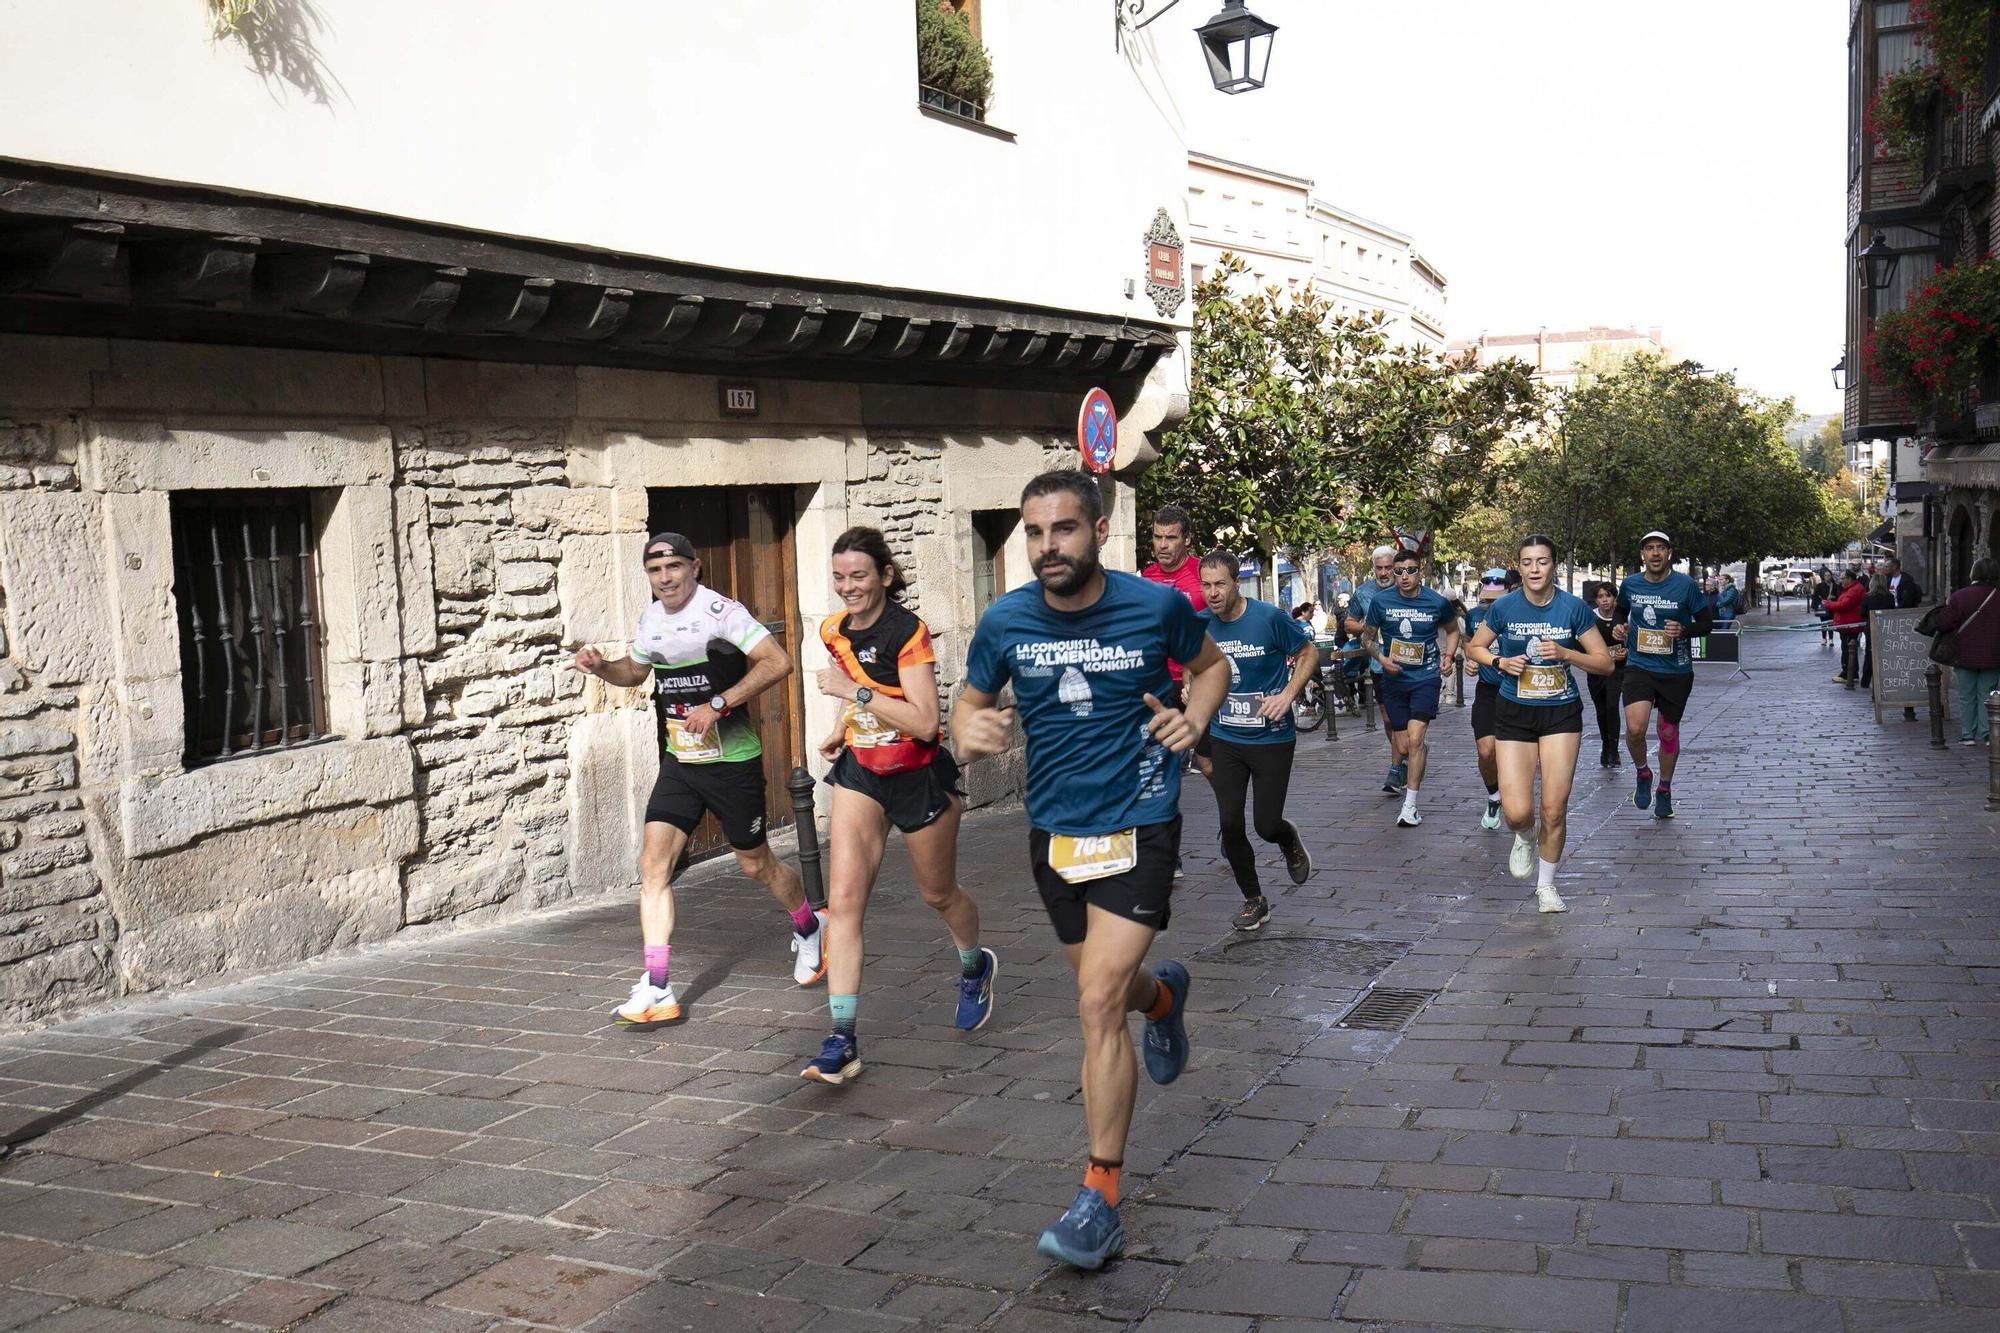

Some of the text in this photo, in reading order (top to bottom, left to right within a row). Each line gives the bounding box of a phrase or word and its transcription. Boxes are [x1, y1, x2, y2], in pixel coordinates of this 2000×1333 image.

[1516, 627, 1564, 635] ALMENDRA
[1016, 639, 1101, 654] LA CONQUISTA
[1646, 635, 1664, 646] 225
[1883, 639, 1926, 653] SANTO
[1034, 645, 1127, 666] ALMENDRA
[1234, 650, 1265, 658] KONKISTA
[1082, 657, 1145, 673] KONKISTA
[663, 674, 709, 688] ACTUALIZA
[1531, 674, 1555, 686] 425
[1883, 678, 1909, 687] CREMA
[1229, 701, 1251, 714] 799
